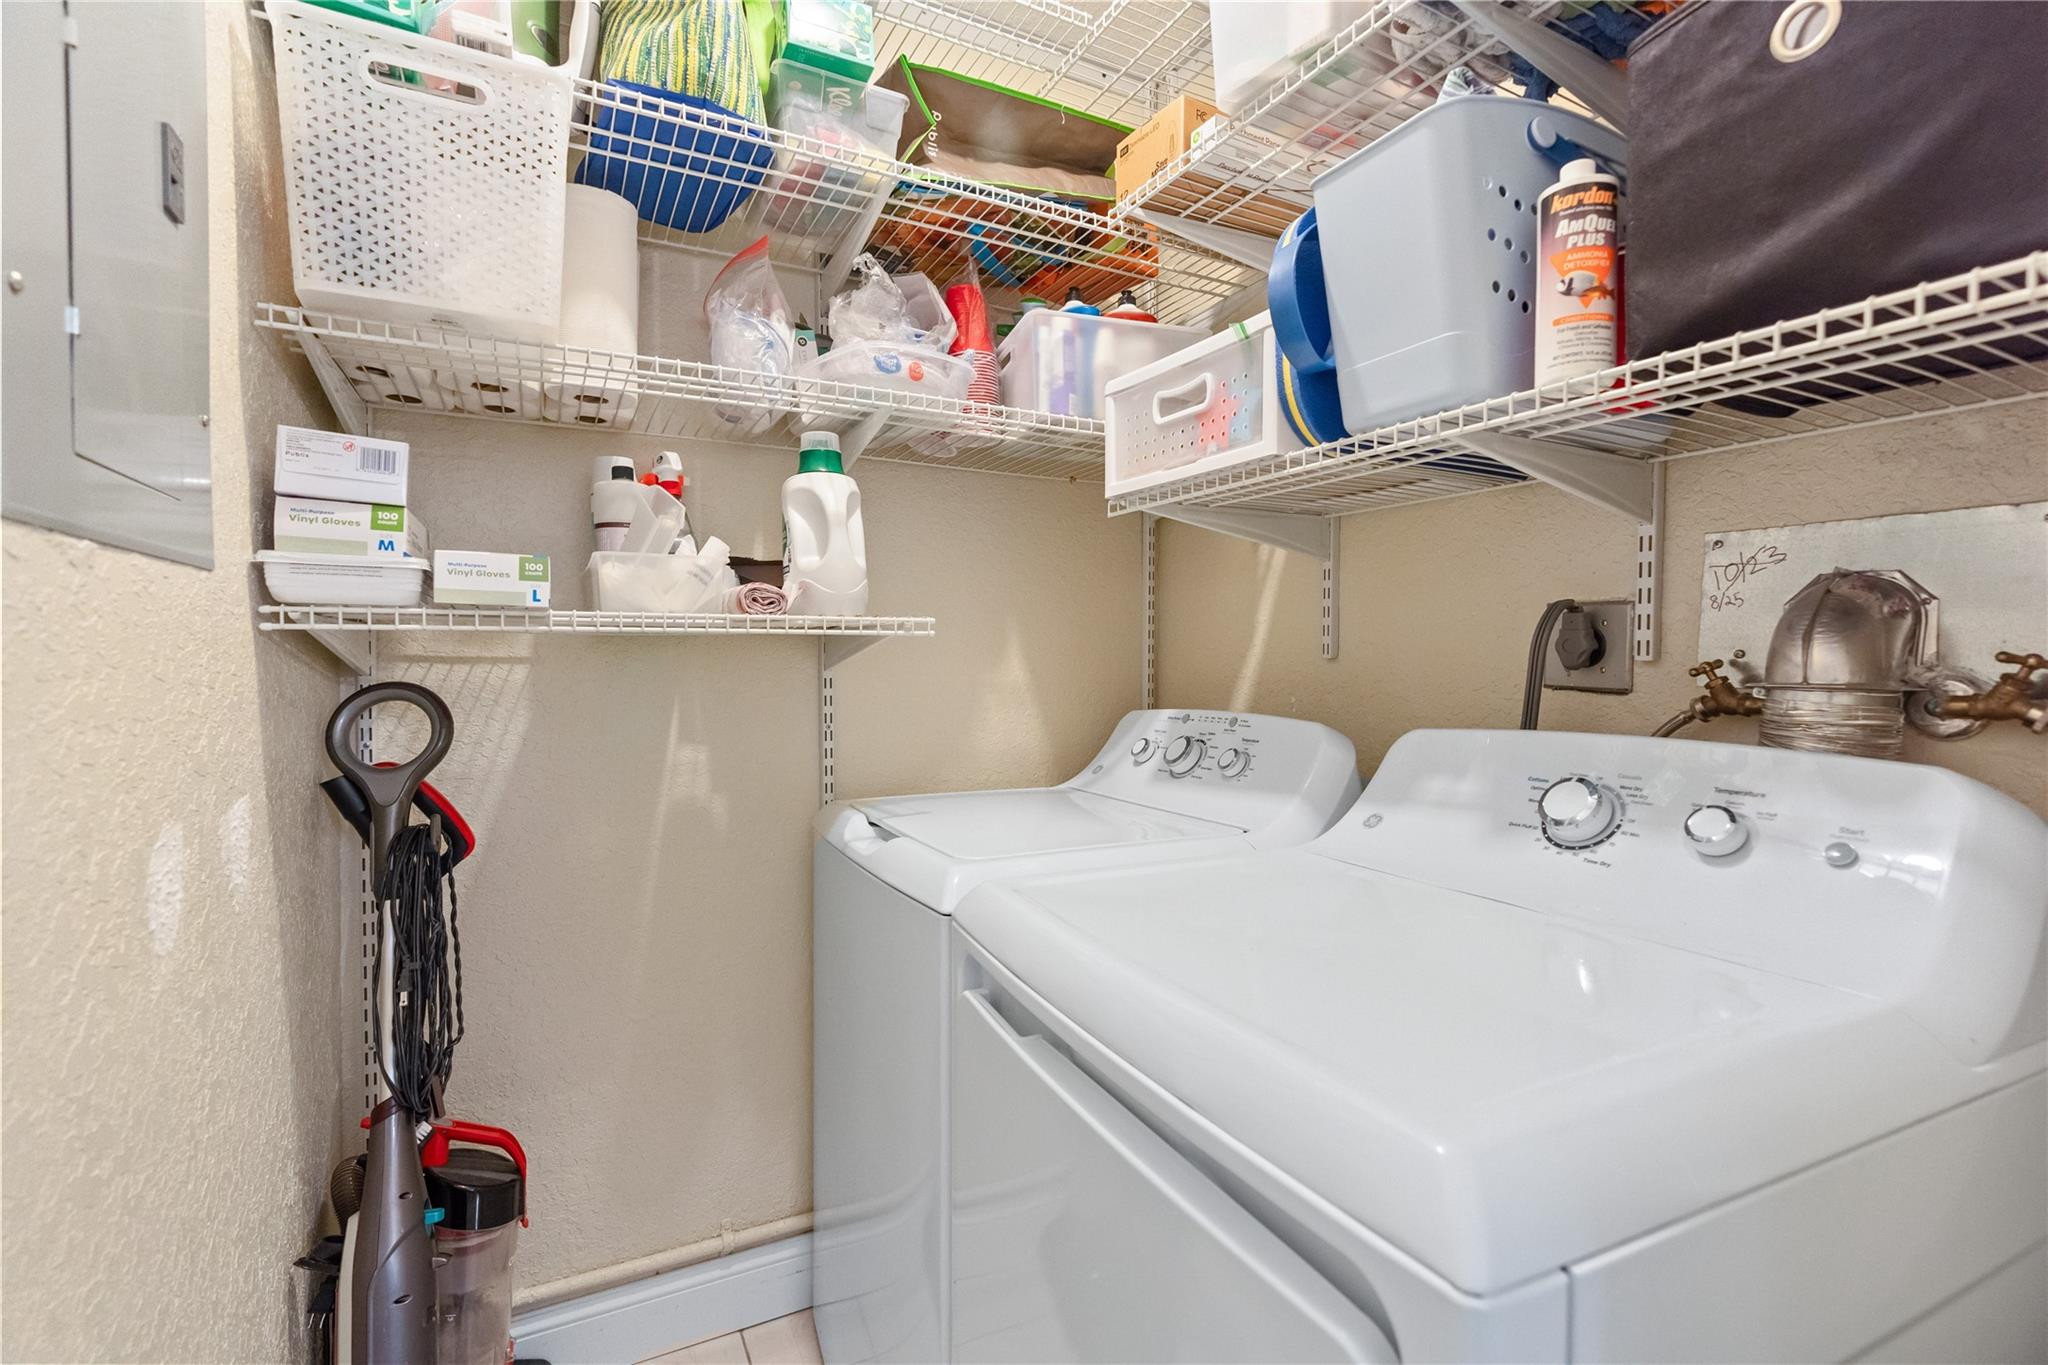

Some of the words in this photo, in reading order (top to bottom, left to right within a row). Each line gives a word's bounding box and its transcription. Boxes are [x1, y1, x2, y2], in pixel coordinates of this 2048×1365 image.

[927, 110, 942, 157] pblix
[1567, 232, 1605, 249] PLUS
[289, 514, 319, 525] Vinyl
[321, 517, 361, 527] Gloves
[377, 511, 399, 520] 100
[378, 540, 395, 551] M
[524, 562, 544, 571] 100
[447, 568, 473, 578] Vinyl
[476, 570, 511, 579] Gloves
[532, 589, 541, 602] L
[1709, 591, 1745, 612] 8/25
[1713, 786, 1766, 798] Temperature
